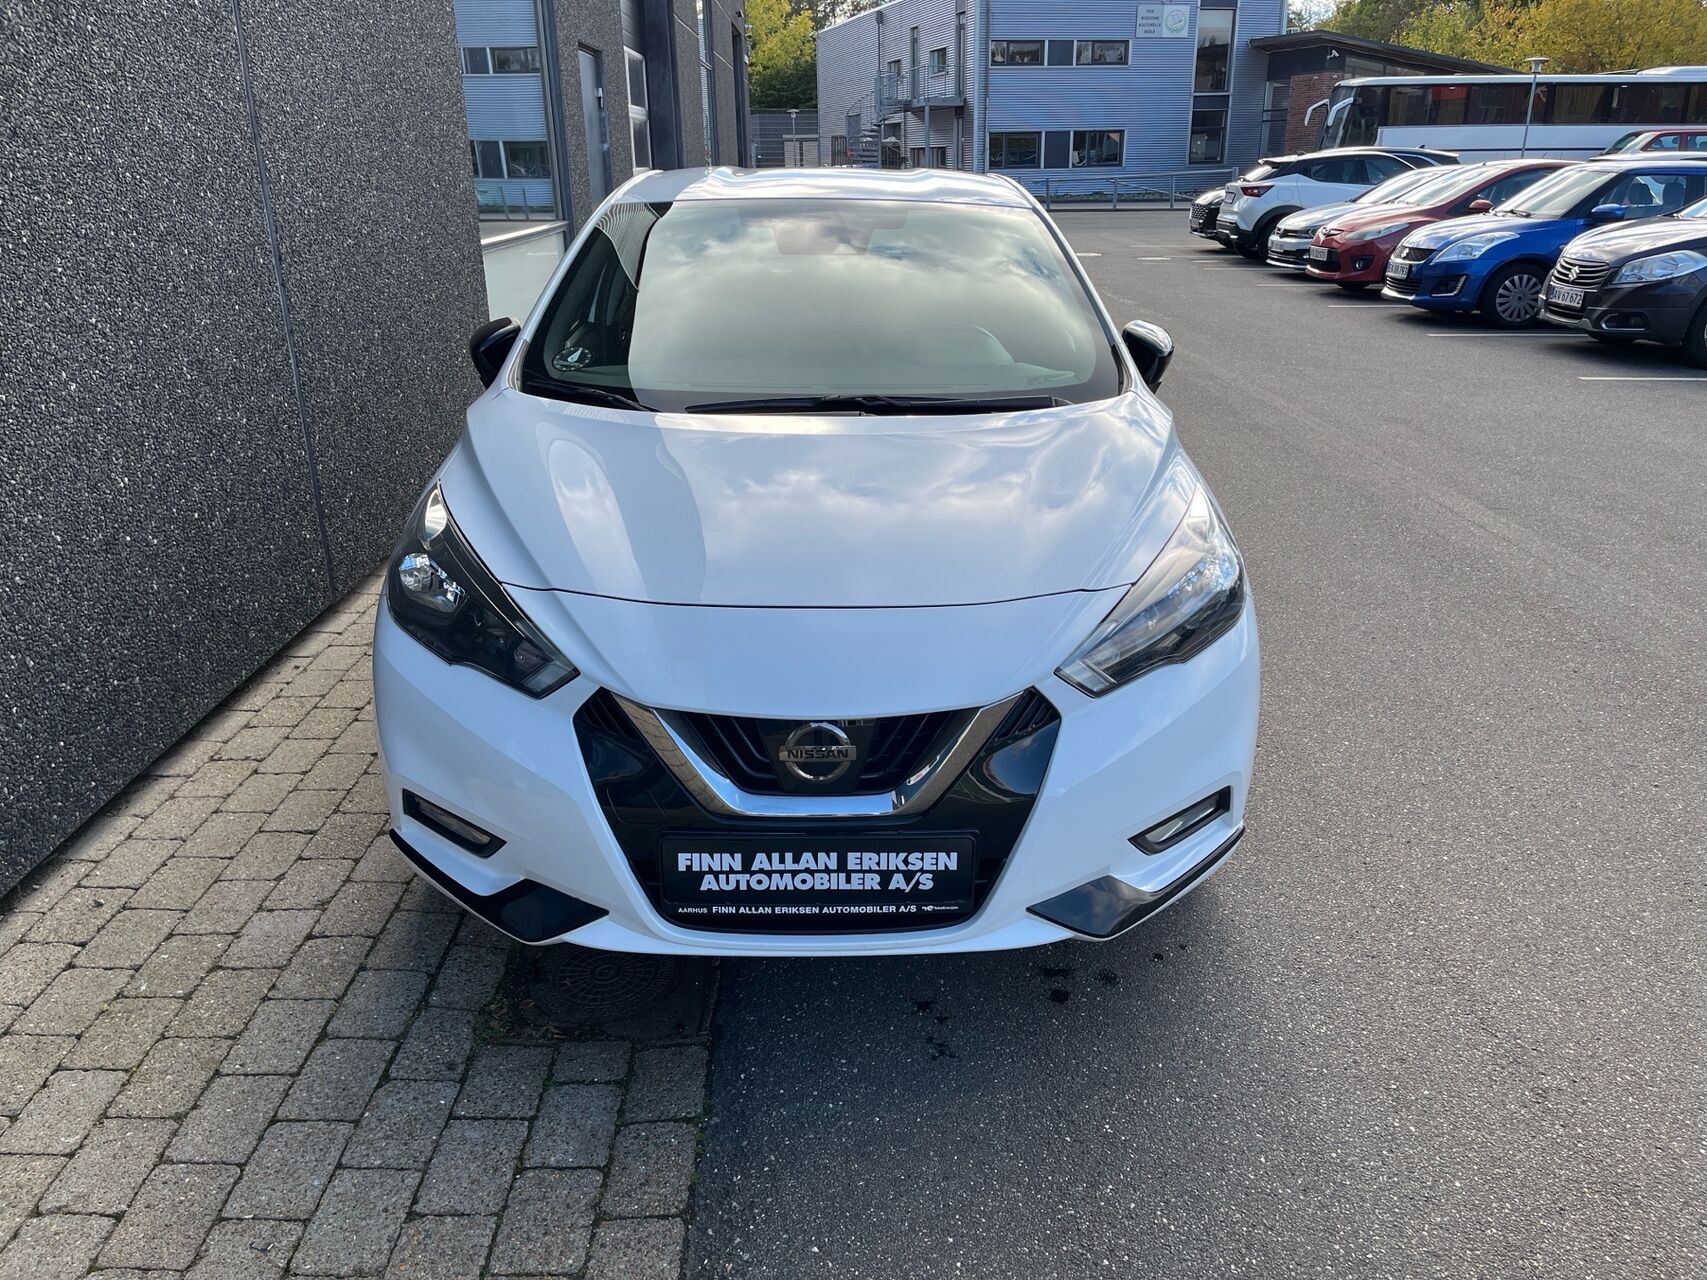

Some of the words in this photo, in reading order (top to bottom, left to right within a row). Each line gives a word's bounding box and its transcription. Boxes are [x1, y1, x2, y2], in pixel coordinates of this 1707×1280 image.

[787, 748, 849, 760] NISSAN
[678, 853, 742, 871] FINN
[751, 852, 838, 871] ALLAN
[847, 852, 958, 871] ERIKSEN
[700, 873, 881, 891] AUTOMOBILER
[888, 872, 934, 893] A/S
[712, 906, 736, 914] FINN
[739, 906, 772, 914] ALLAN
[775, 906, 819, 914] ERIKSEN
[822, 905, 896, 914] AUTOMOBILER
[899, 905, 917, 913] A/S
